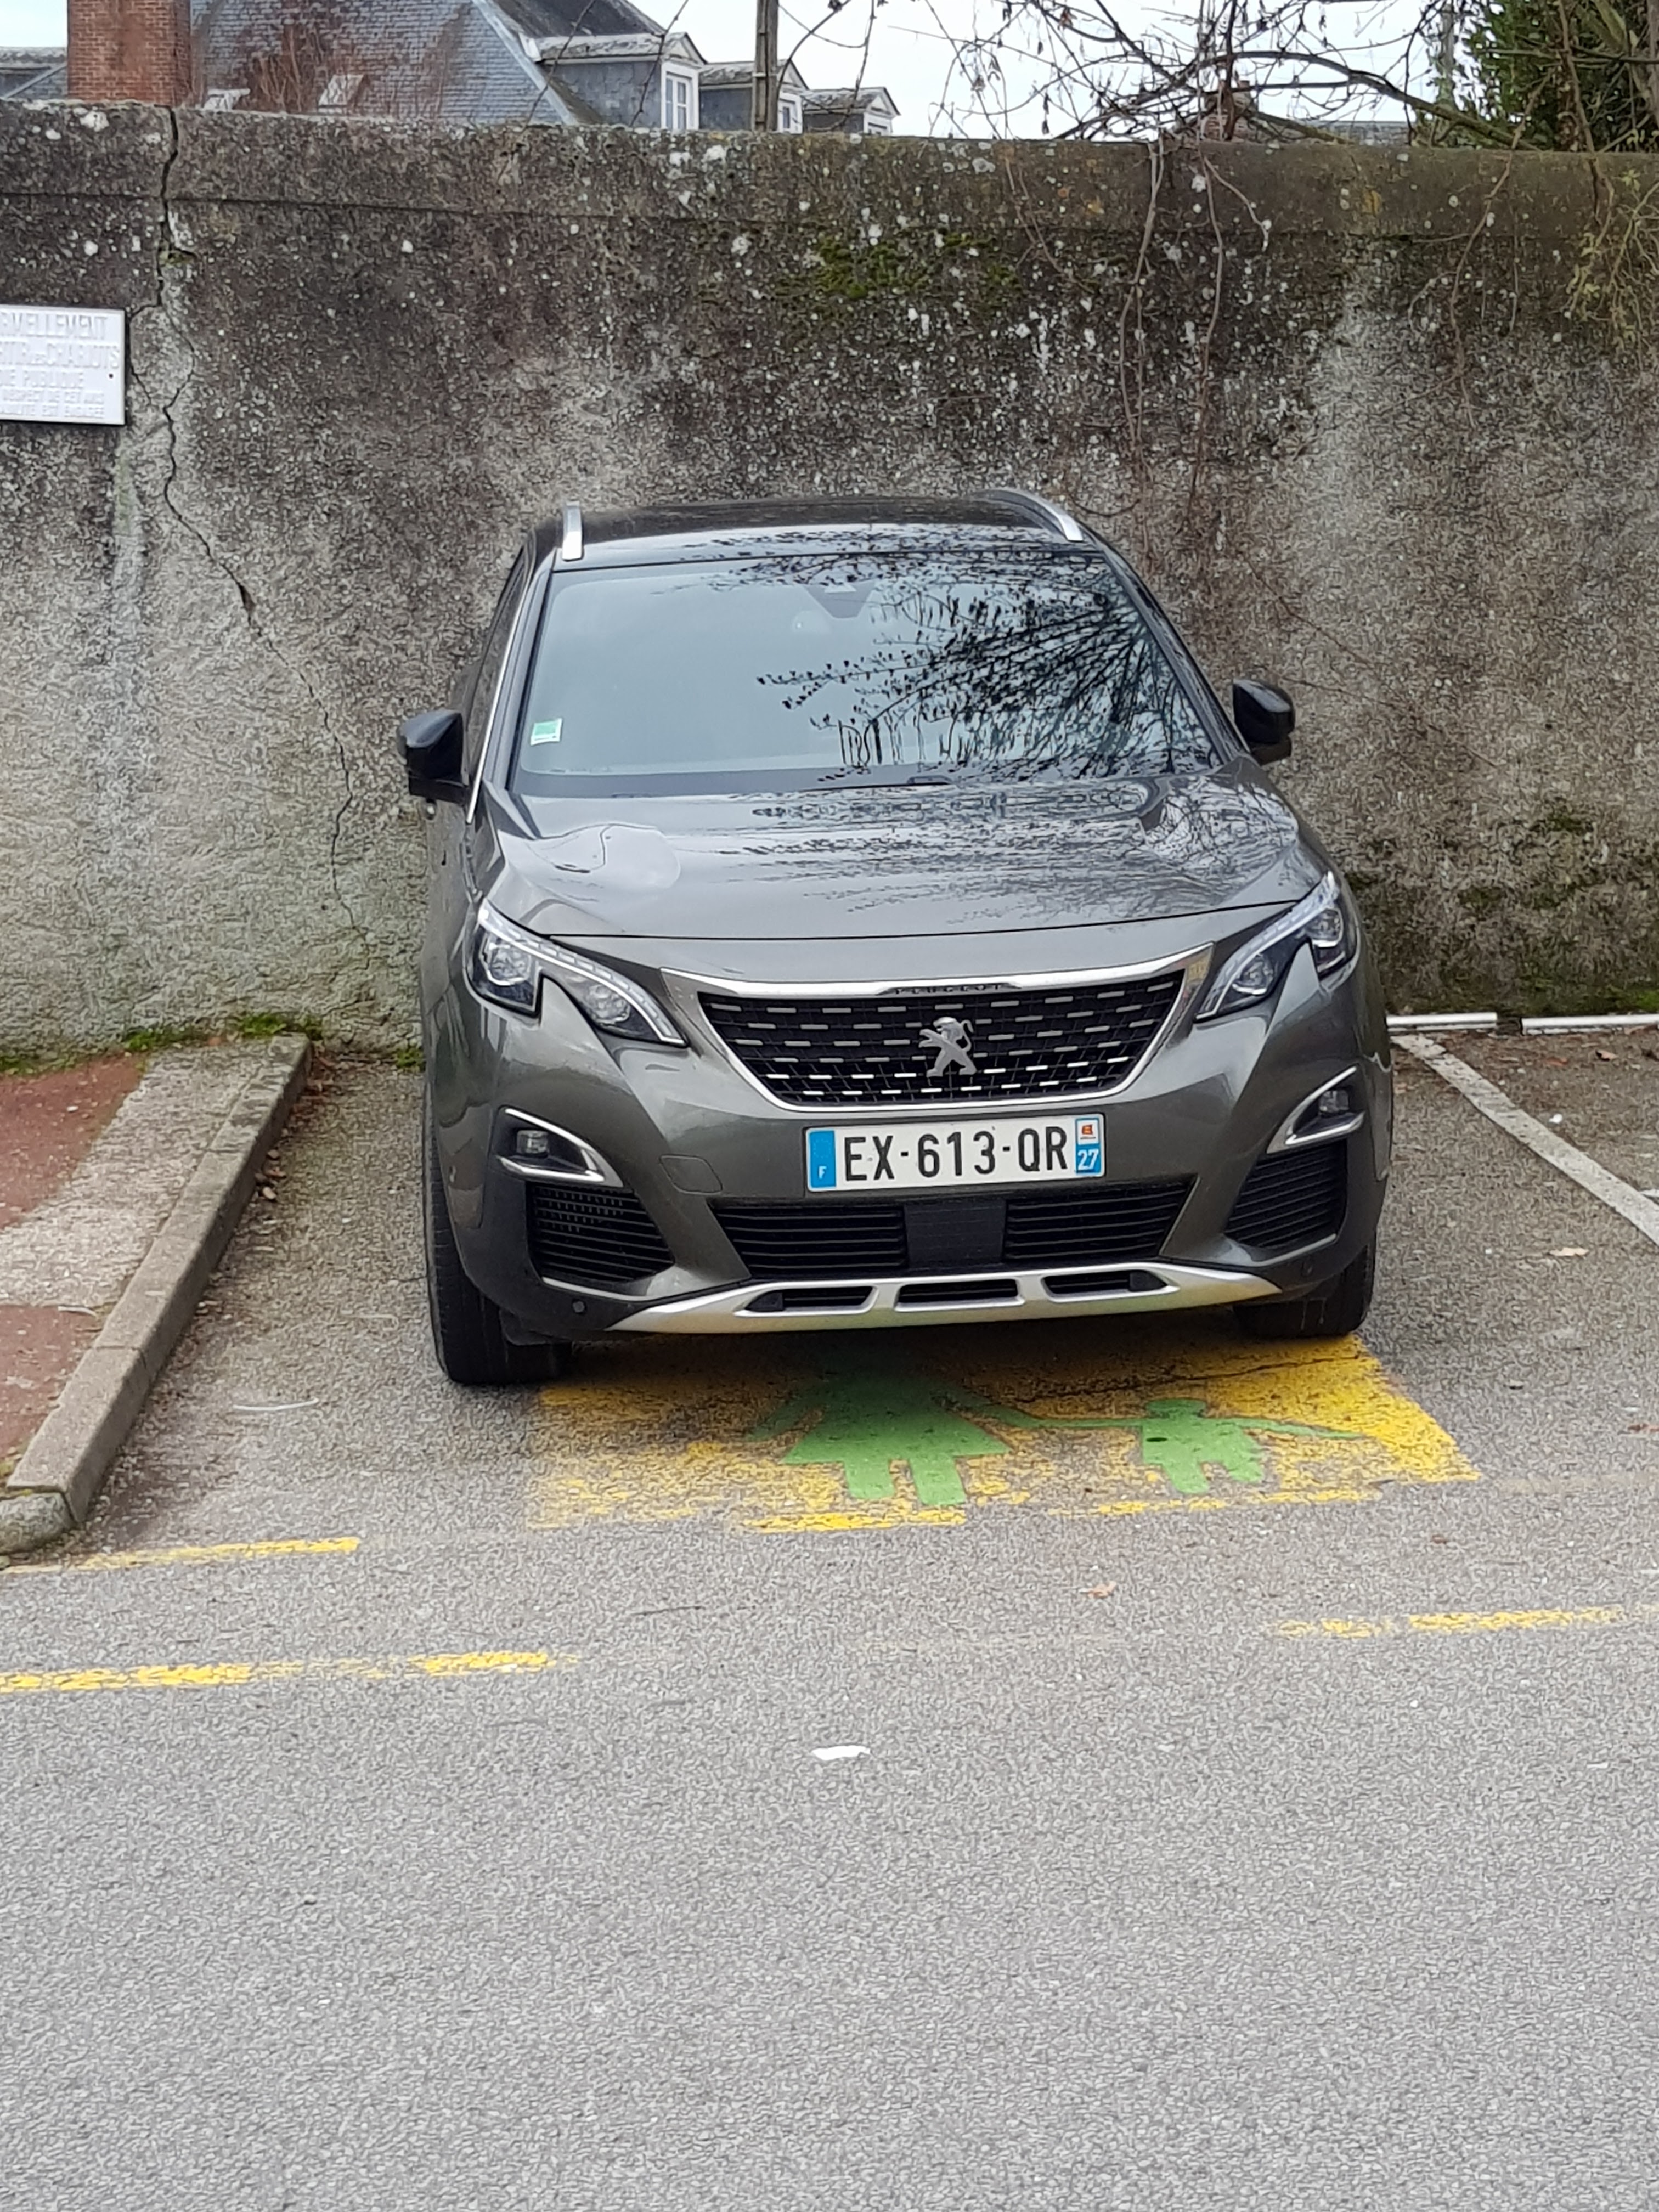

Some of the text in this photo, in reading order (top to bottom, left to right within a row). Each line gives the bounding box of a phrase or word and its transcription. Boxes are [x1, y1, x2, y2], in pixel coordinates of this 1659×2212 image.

[895, 984, 1001, 995] PEUGEOT
[844, 1126, 1068, 1181] EX-613-QR
[1077, 1149, 1099, 1170] 27
[819, 1165, 827, 1180] F
